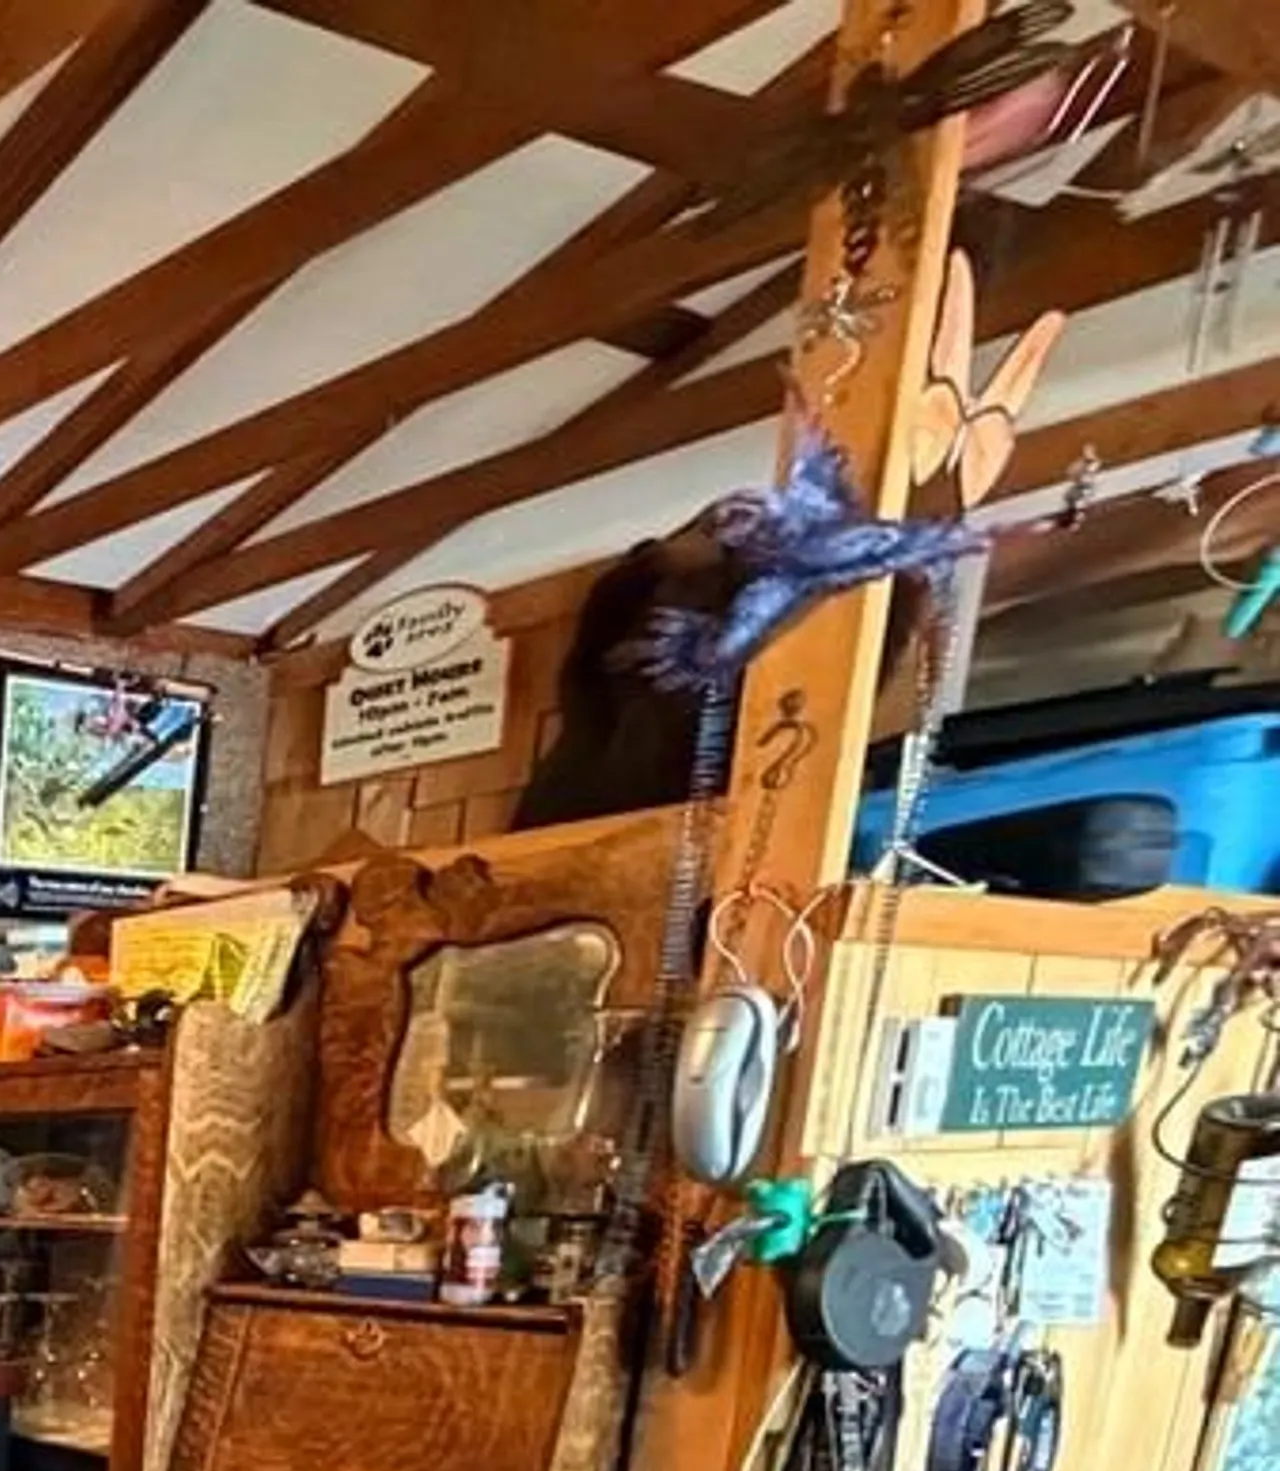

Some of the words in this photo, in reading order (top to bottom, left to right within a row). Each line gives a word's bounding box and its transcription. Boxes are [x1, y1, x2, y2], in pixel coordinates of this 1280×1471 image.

[971, 1000, 1077, 1084] Cottage
[1080, 1004, 1140, 1068] Life
[996, 1083, 1035, 1124] The
[1034, 1083, 1078, 1125] Best
[1078, 1083, 1118, 1121] Life
